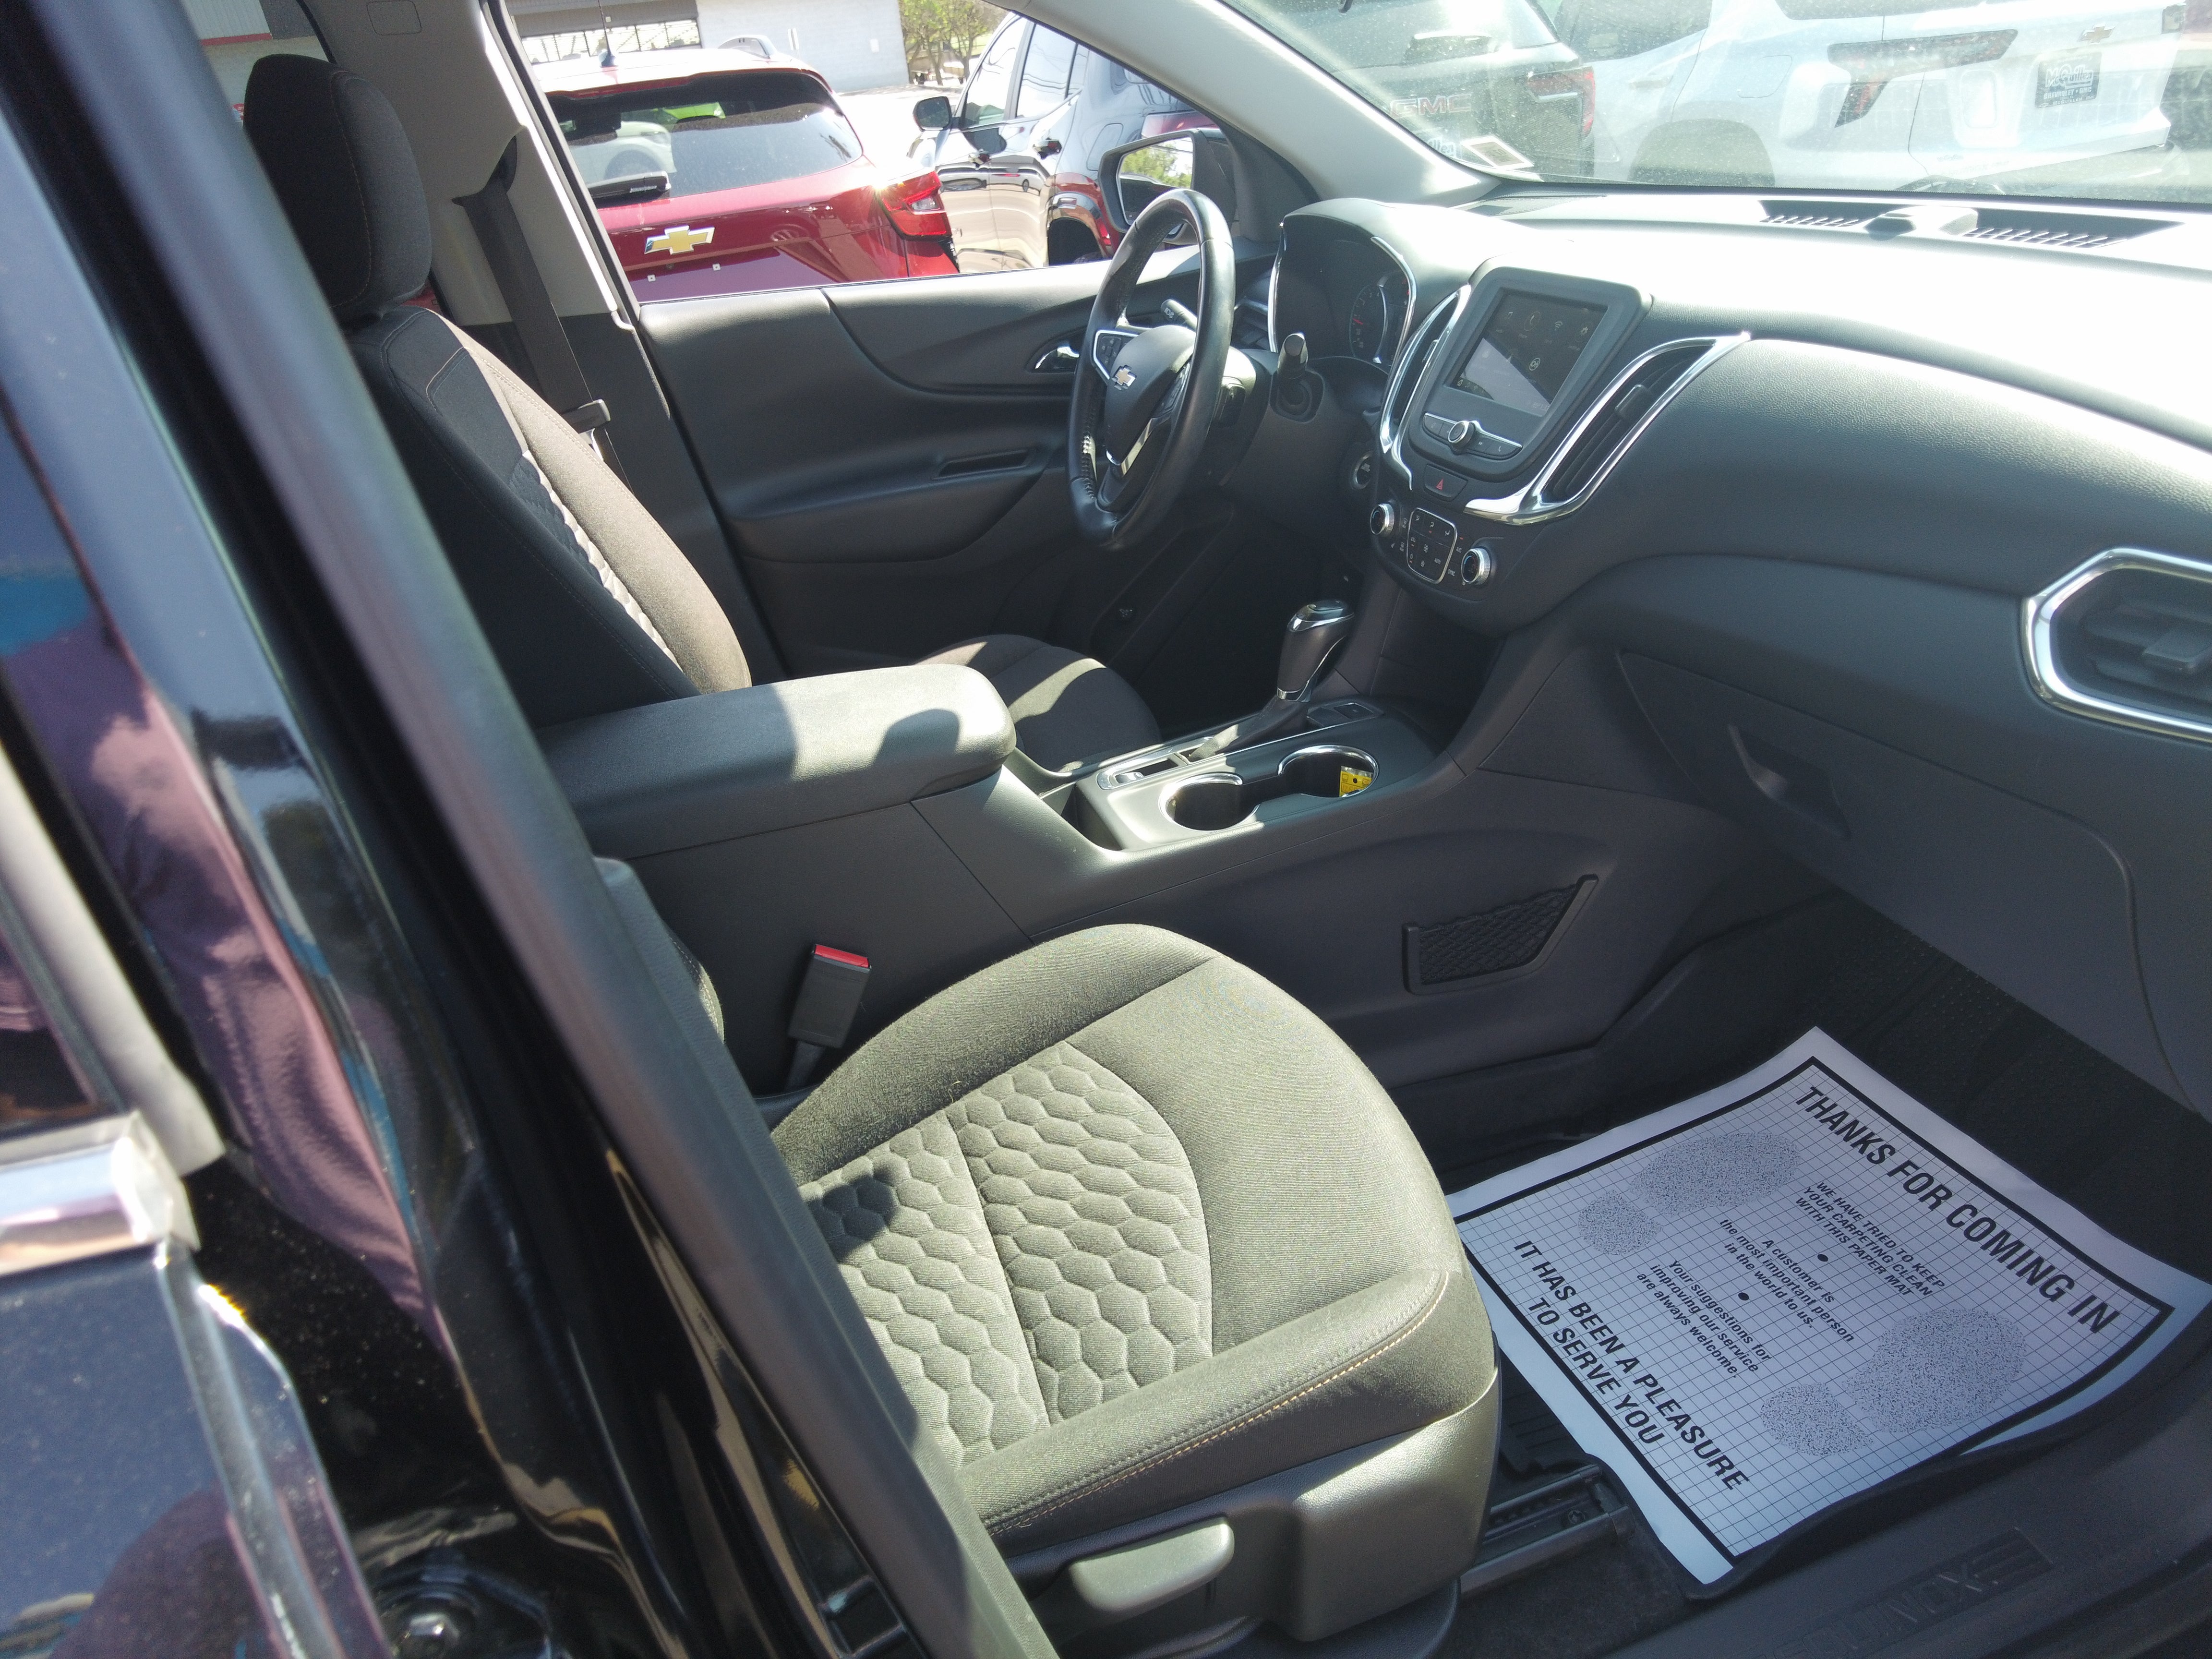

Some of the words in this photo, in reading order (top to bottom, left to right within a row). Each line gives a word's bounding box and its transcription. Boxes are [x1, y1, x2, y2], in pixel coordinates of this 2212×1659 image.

[1390, 94, 1472, 119] GMC
[1795, 1197, 1825, 1222] WITH
[1823, 1221, 1851, 1243] THIS
[1848, 1243, 1887, 1274] PAPER
[1884, 1274, 1914, 1296] MAT
[1796, 1087, 1896, 1164] THANKS
[1887, 1160, 1952, 1211] FOR
[1946, 1204, 2075, 1302] COMING
[2067, 1295, 2120, 1334] IN
[1803, 1187, 1834, 1213] YOUR
[1832, 1213, 1894, 1263] CARPETING
[1892, 1263, 1933, 1296] CLEAN
[1816, 1182, 1837, 1198] WE
[1833, 1197, 1864, 1221] HAVE
[1863, 1220, 1896, 1248] TRIED
[1896, 1248, 1914, 1262] TO
[1911, 1263, 1945, 1287] KEEP
[1650, 1264, 1701, 1314] improving
[1699, 1314, 1720, 1332] our
[1718, 1333, 1758, 1372] service
[1670, 1260, 1694, 1283] Your
[1691, 1284, 1753, 1344] suggestions
[1752, 1344, 1772, 1360] for
[1720, 1219, 1738, 1235] the
[1736, 1236, 1765, 1259] most
[1762, 1258, 1816, 1306] important
[1811, 1306, 1854, 1342] person
[1724, 1242, 1737, 1254] in
[1736, 1253, 1755, 1270] the
[1754, 1271, 1788, 1299] world
[1784, 1298, 1798, 1310] to
[1797, 1310, 1813, 1328] us.
[1762, 1239, 1774, 1249] A
[1772, 1248, 1823, 1292] customer
[1821, 1292, 1834, 1303] is
[1514, 1240, 1542, 1258] IT
[1532, 1261, 1576, 1300] HAS
[1568, 1302, 1625, 1354] BEEN
[1615, 1357, 1640, 1374] A
[1633, 1373, 1750, 1490] PLEASURE
[1528, 1297, 1560, 1325] TO
[1552, 1328, 1621, 1395] SERVE
[1614, 1394, 1665, 1444] YOU
[1637, 1274, 1656, 1290] are
[1654, 1291, 1691, 1326] always
[1689, 1326, 1737, 1378] welcome.
